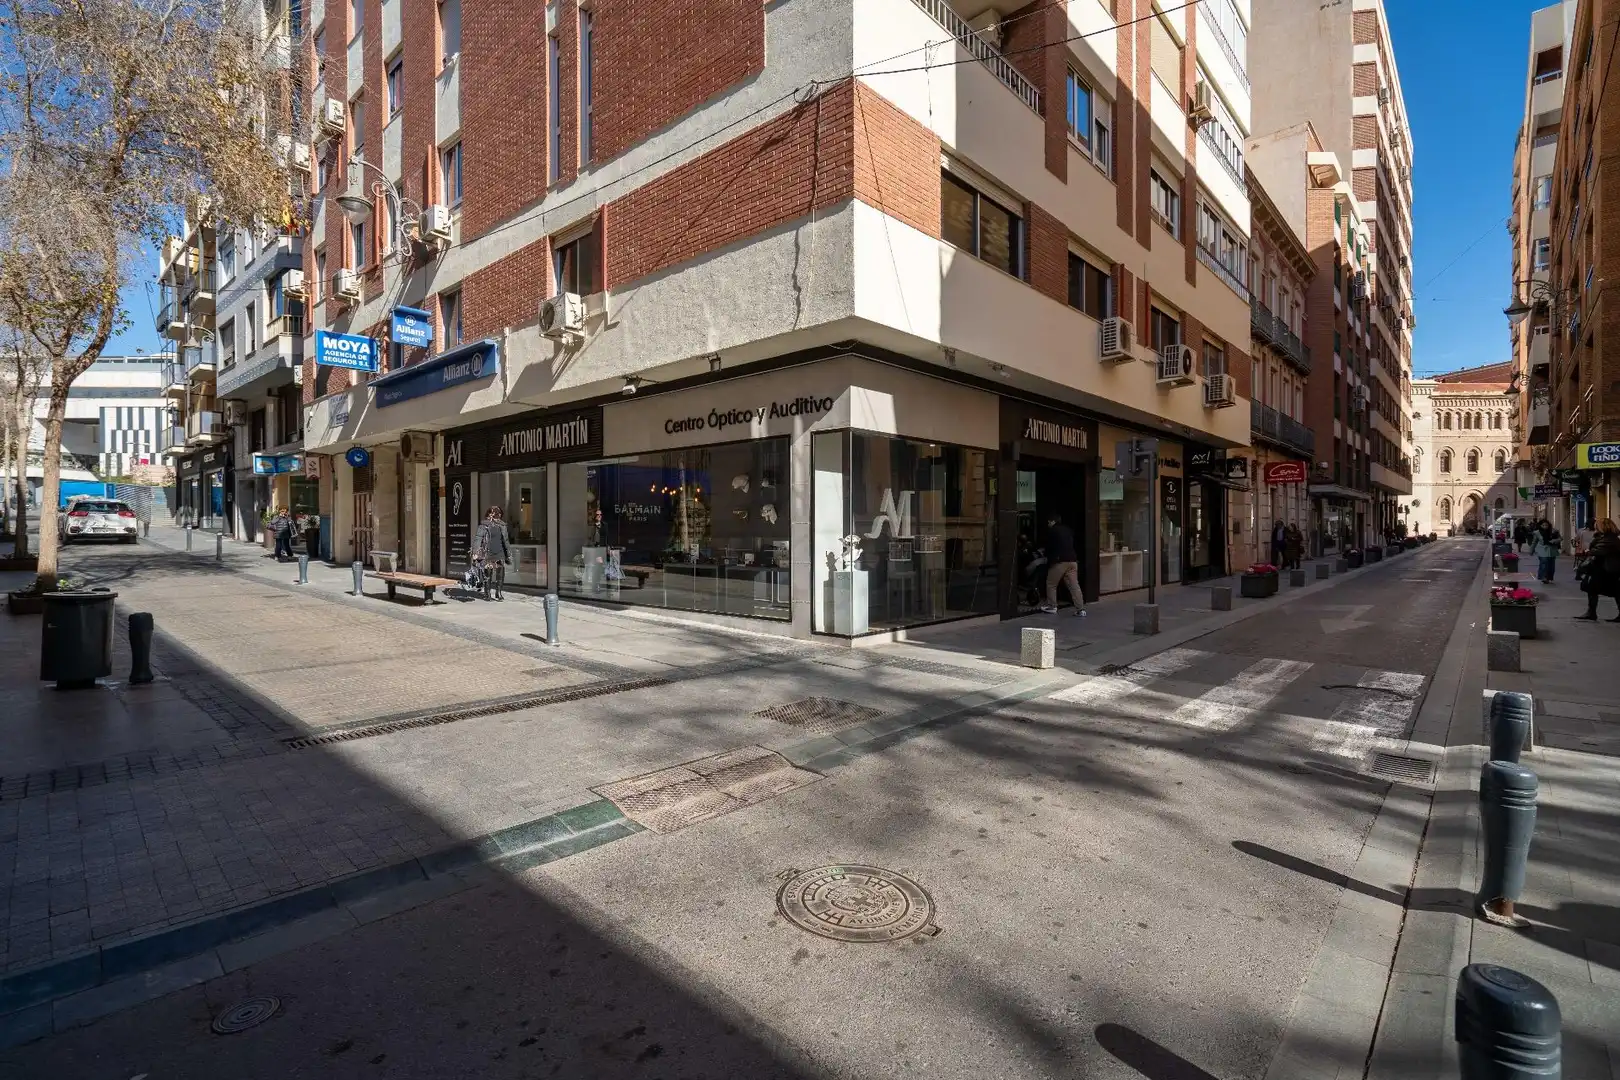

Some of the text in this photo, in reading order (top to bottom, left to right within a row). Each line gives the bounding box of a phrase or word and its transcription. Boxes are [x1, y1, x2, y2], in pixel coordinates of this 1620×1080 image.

[396, 324, 425, 337] Allianz
[323, 337, 370, 354] MOYA
[323, 356, 357, 365] SEGUROS
[325, 350, 356, 359] AGENCIA
[442, 362, 469, 382] Allianz
[664, 395, 834, 434] Centro Óptico y Auditivo
[498, 415, 588, 456] ANTONIO MARTÍN
[1024, 418, 1087, 449] ANTONIO MARTÍN
[1592, 445, 1620, 454] LOOK
[614, 504, 661, 515] BALMAIN
